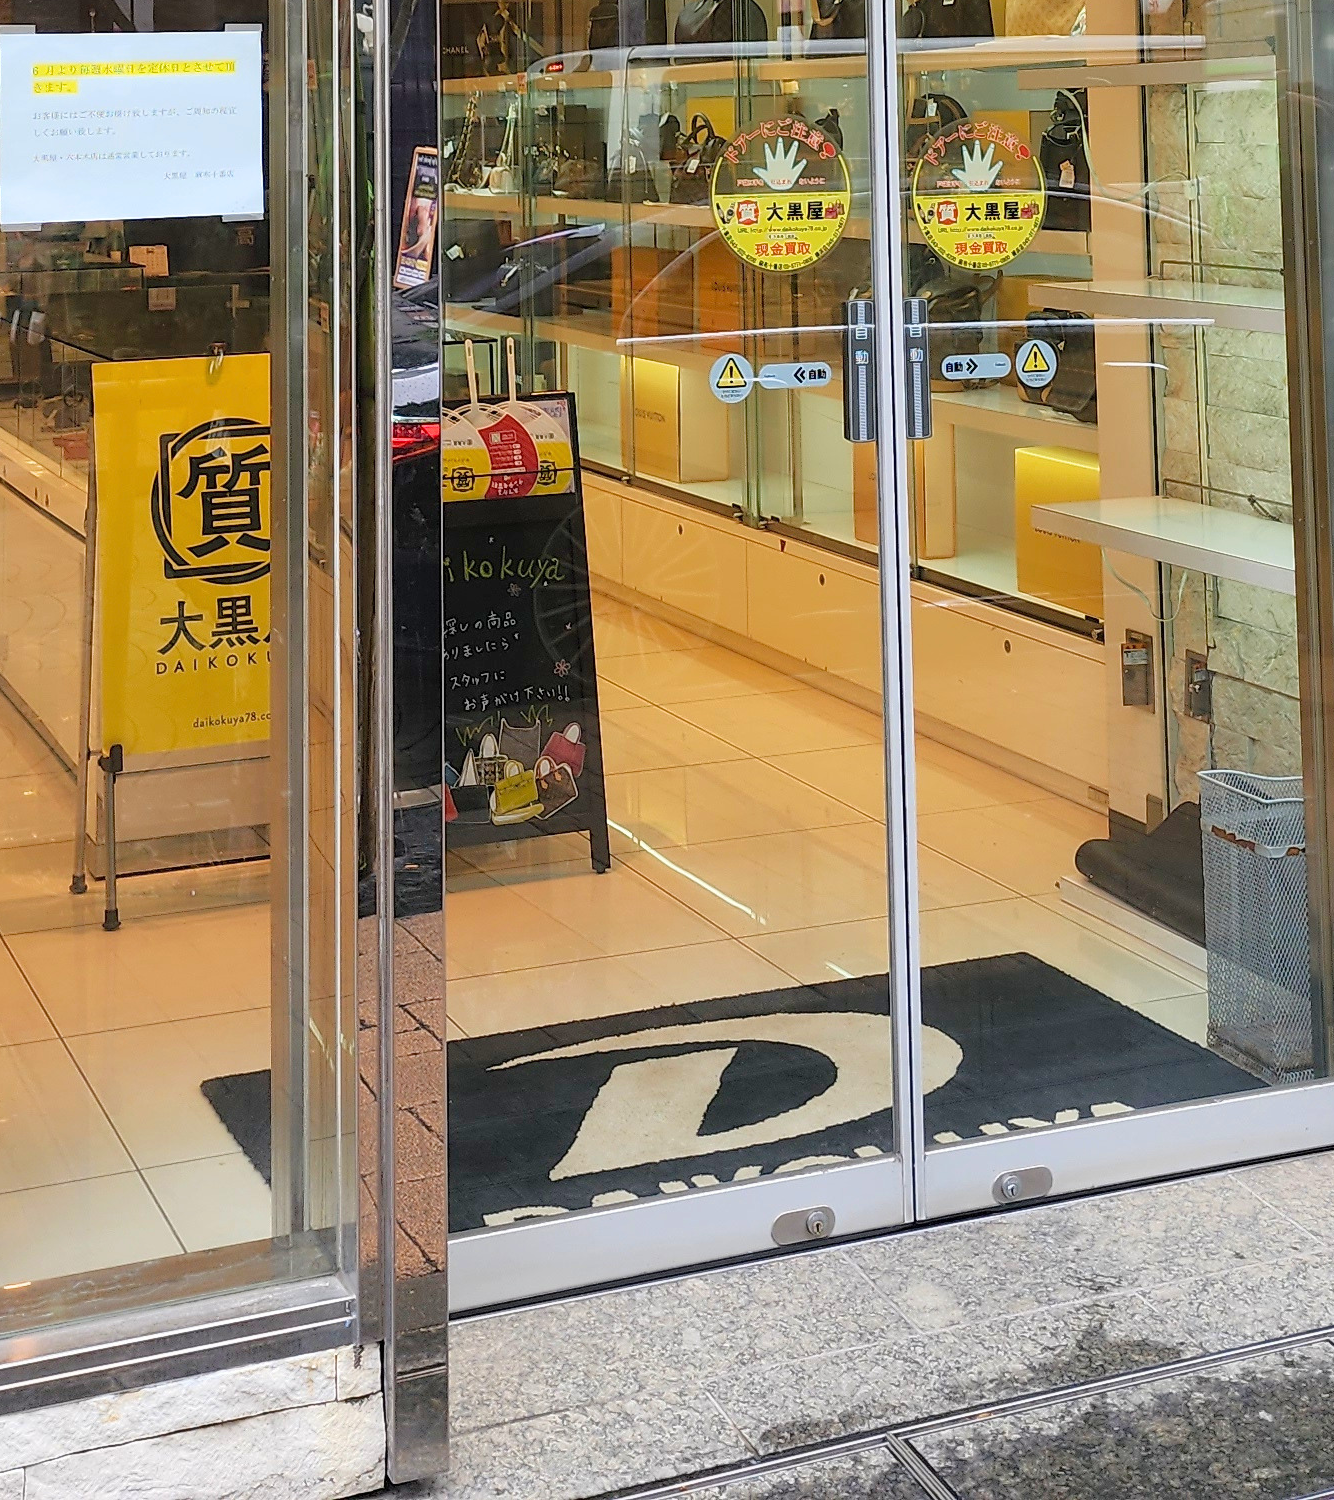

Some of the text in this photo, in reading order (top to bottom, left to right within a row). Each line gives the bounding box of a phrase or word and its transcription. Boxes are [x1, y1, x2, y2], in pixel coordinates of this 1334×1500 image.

[766, 201, 825, 221] 大黒屋
[965, 201, 1020, 221] 大黒屋
[755, 242, 811, 257] 現金買取
[955, 241, 1008, 255] 現金買取
[809, 369, 827, 380] 自動
[946, 361, 963, 373] 自動
[157, 595, 270, 655] 大黒
[450, 670, 506, 690] スタッフに
